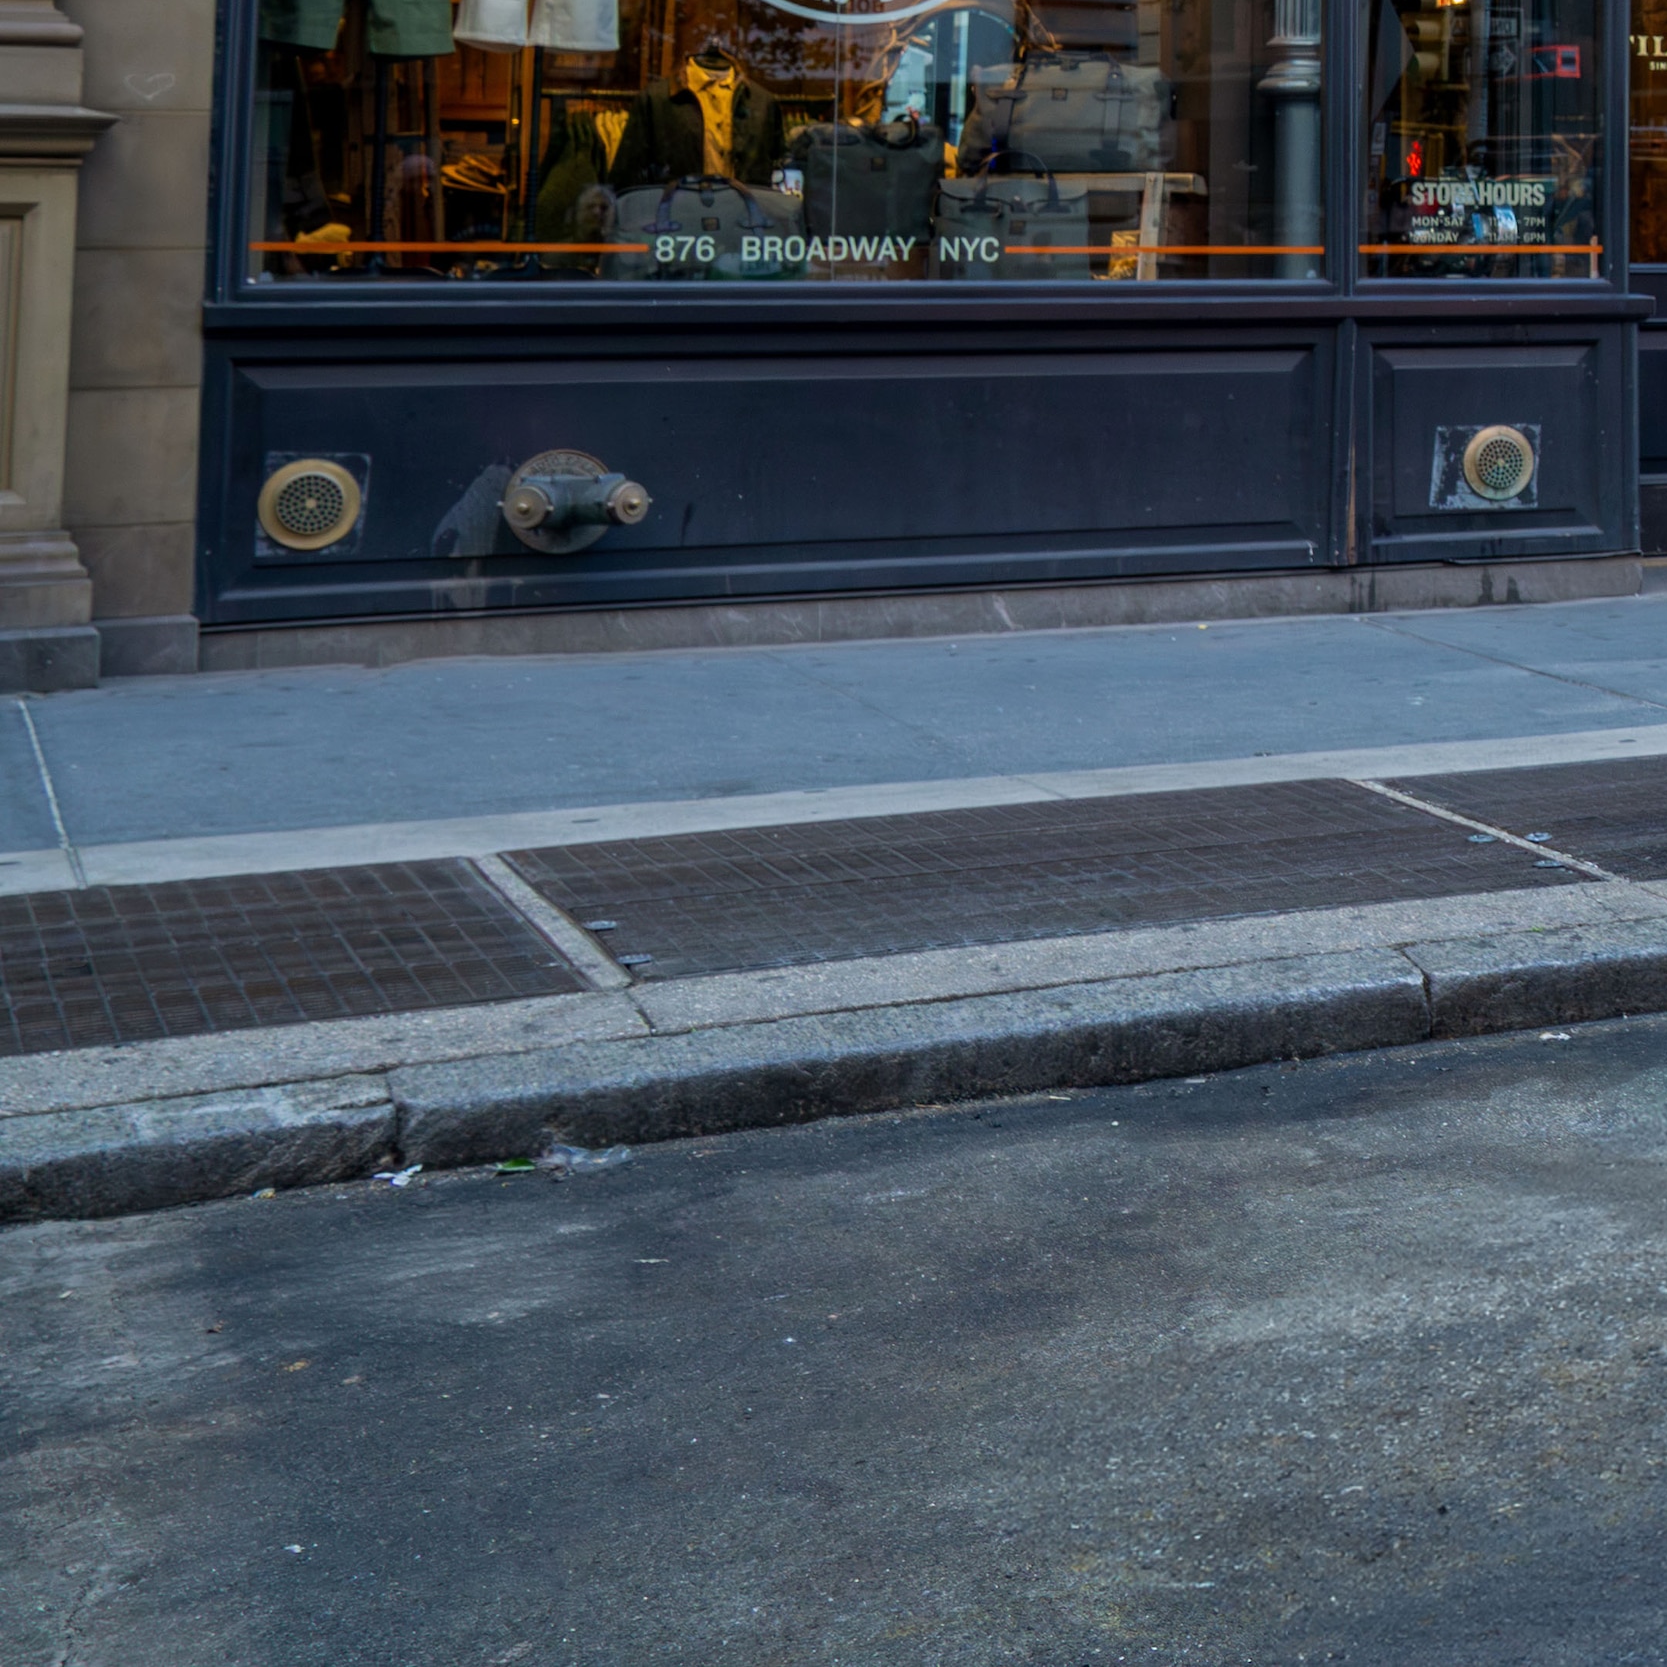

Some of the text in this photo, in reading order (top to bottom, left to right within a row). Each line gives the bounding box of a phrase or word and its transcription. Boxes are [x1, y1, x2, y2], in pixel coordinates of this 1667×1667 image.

[1411, 181, 1546, 207] STORE HOURS
[1523, 216, 1546, 227] 7PM
[1412, 232, 1459, 243] SUNDAY
[1523, 232, 1546, 243] 6PM
[655, 236, 1000, 263] 876 BROADWAY NYC
